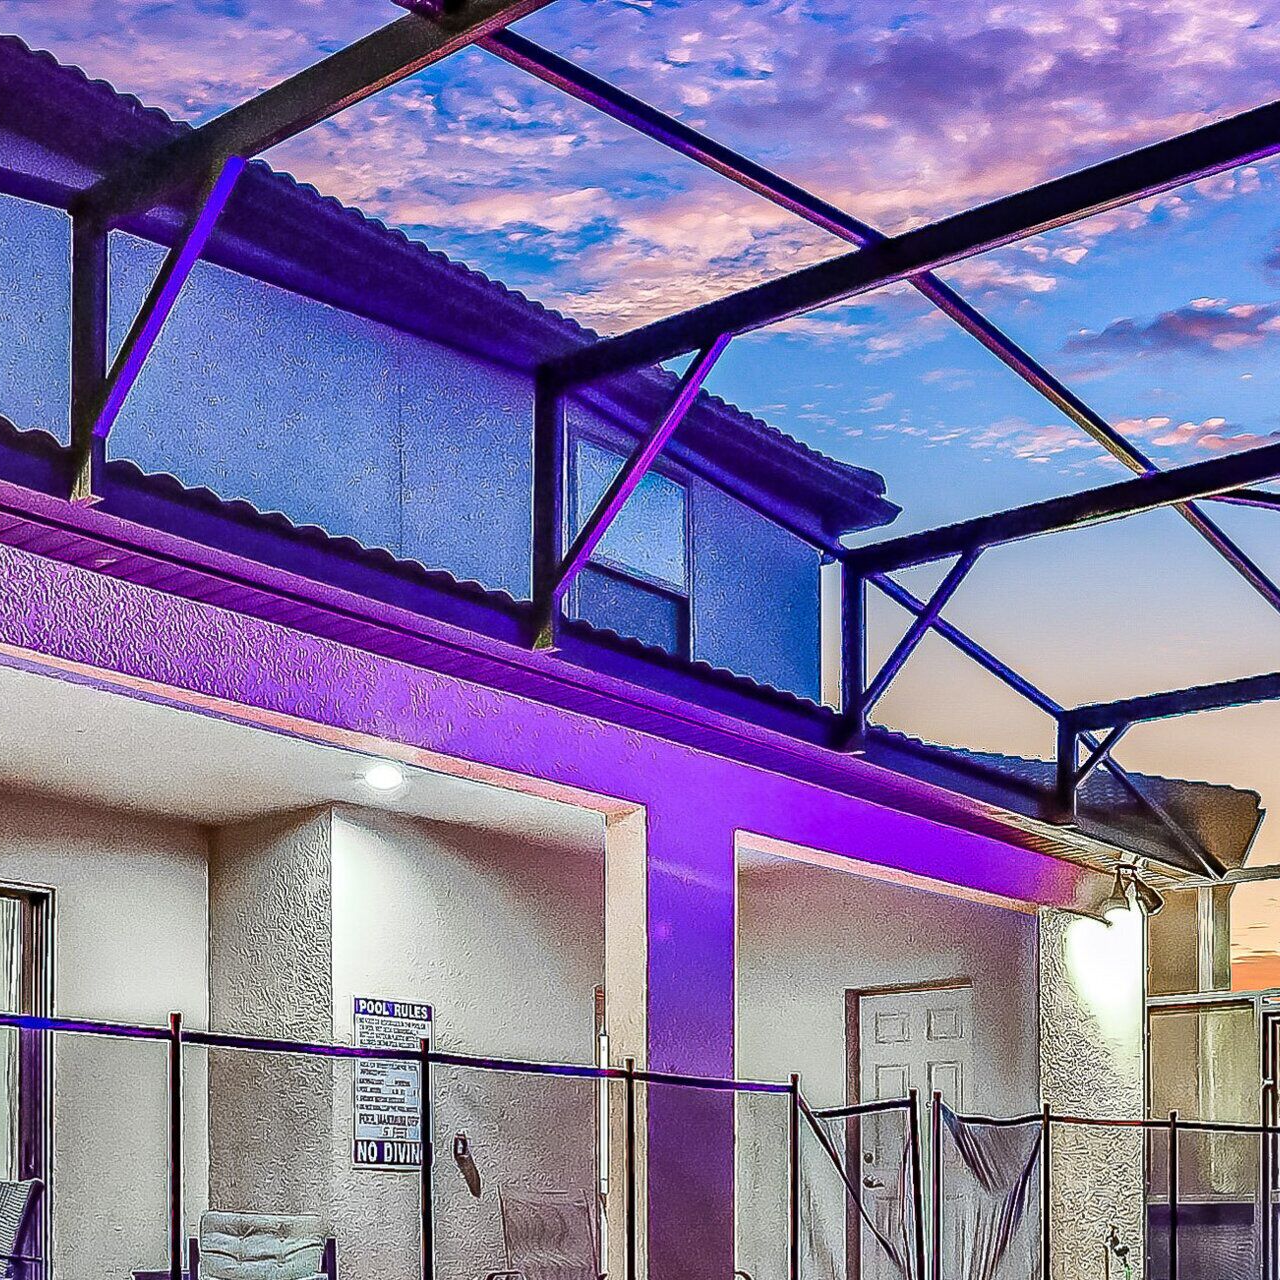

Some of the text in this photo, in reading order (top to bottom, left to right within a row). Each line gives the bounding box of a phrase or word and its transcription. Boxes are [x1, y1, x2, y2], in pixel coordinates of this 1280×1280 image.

[359, 999, 428, 1019] POOL RULES
[357, 1141, 420, 1164] NO DIVIN
